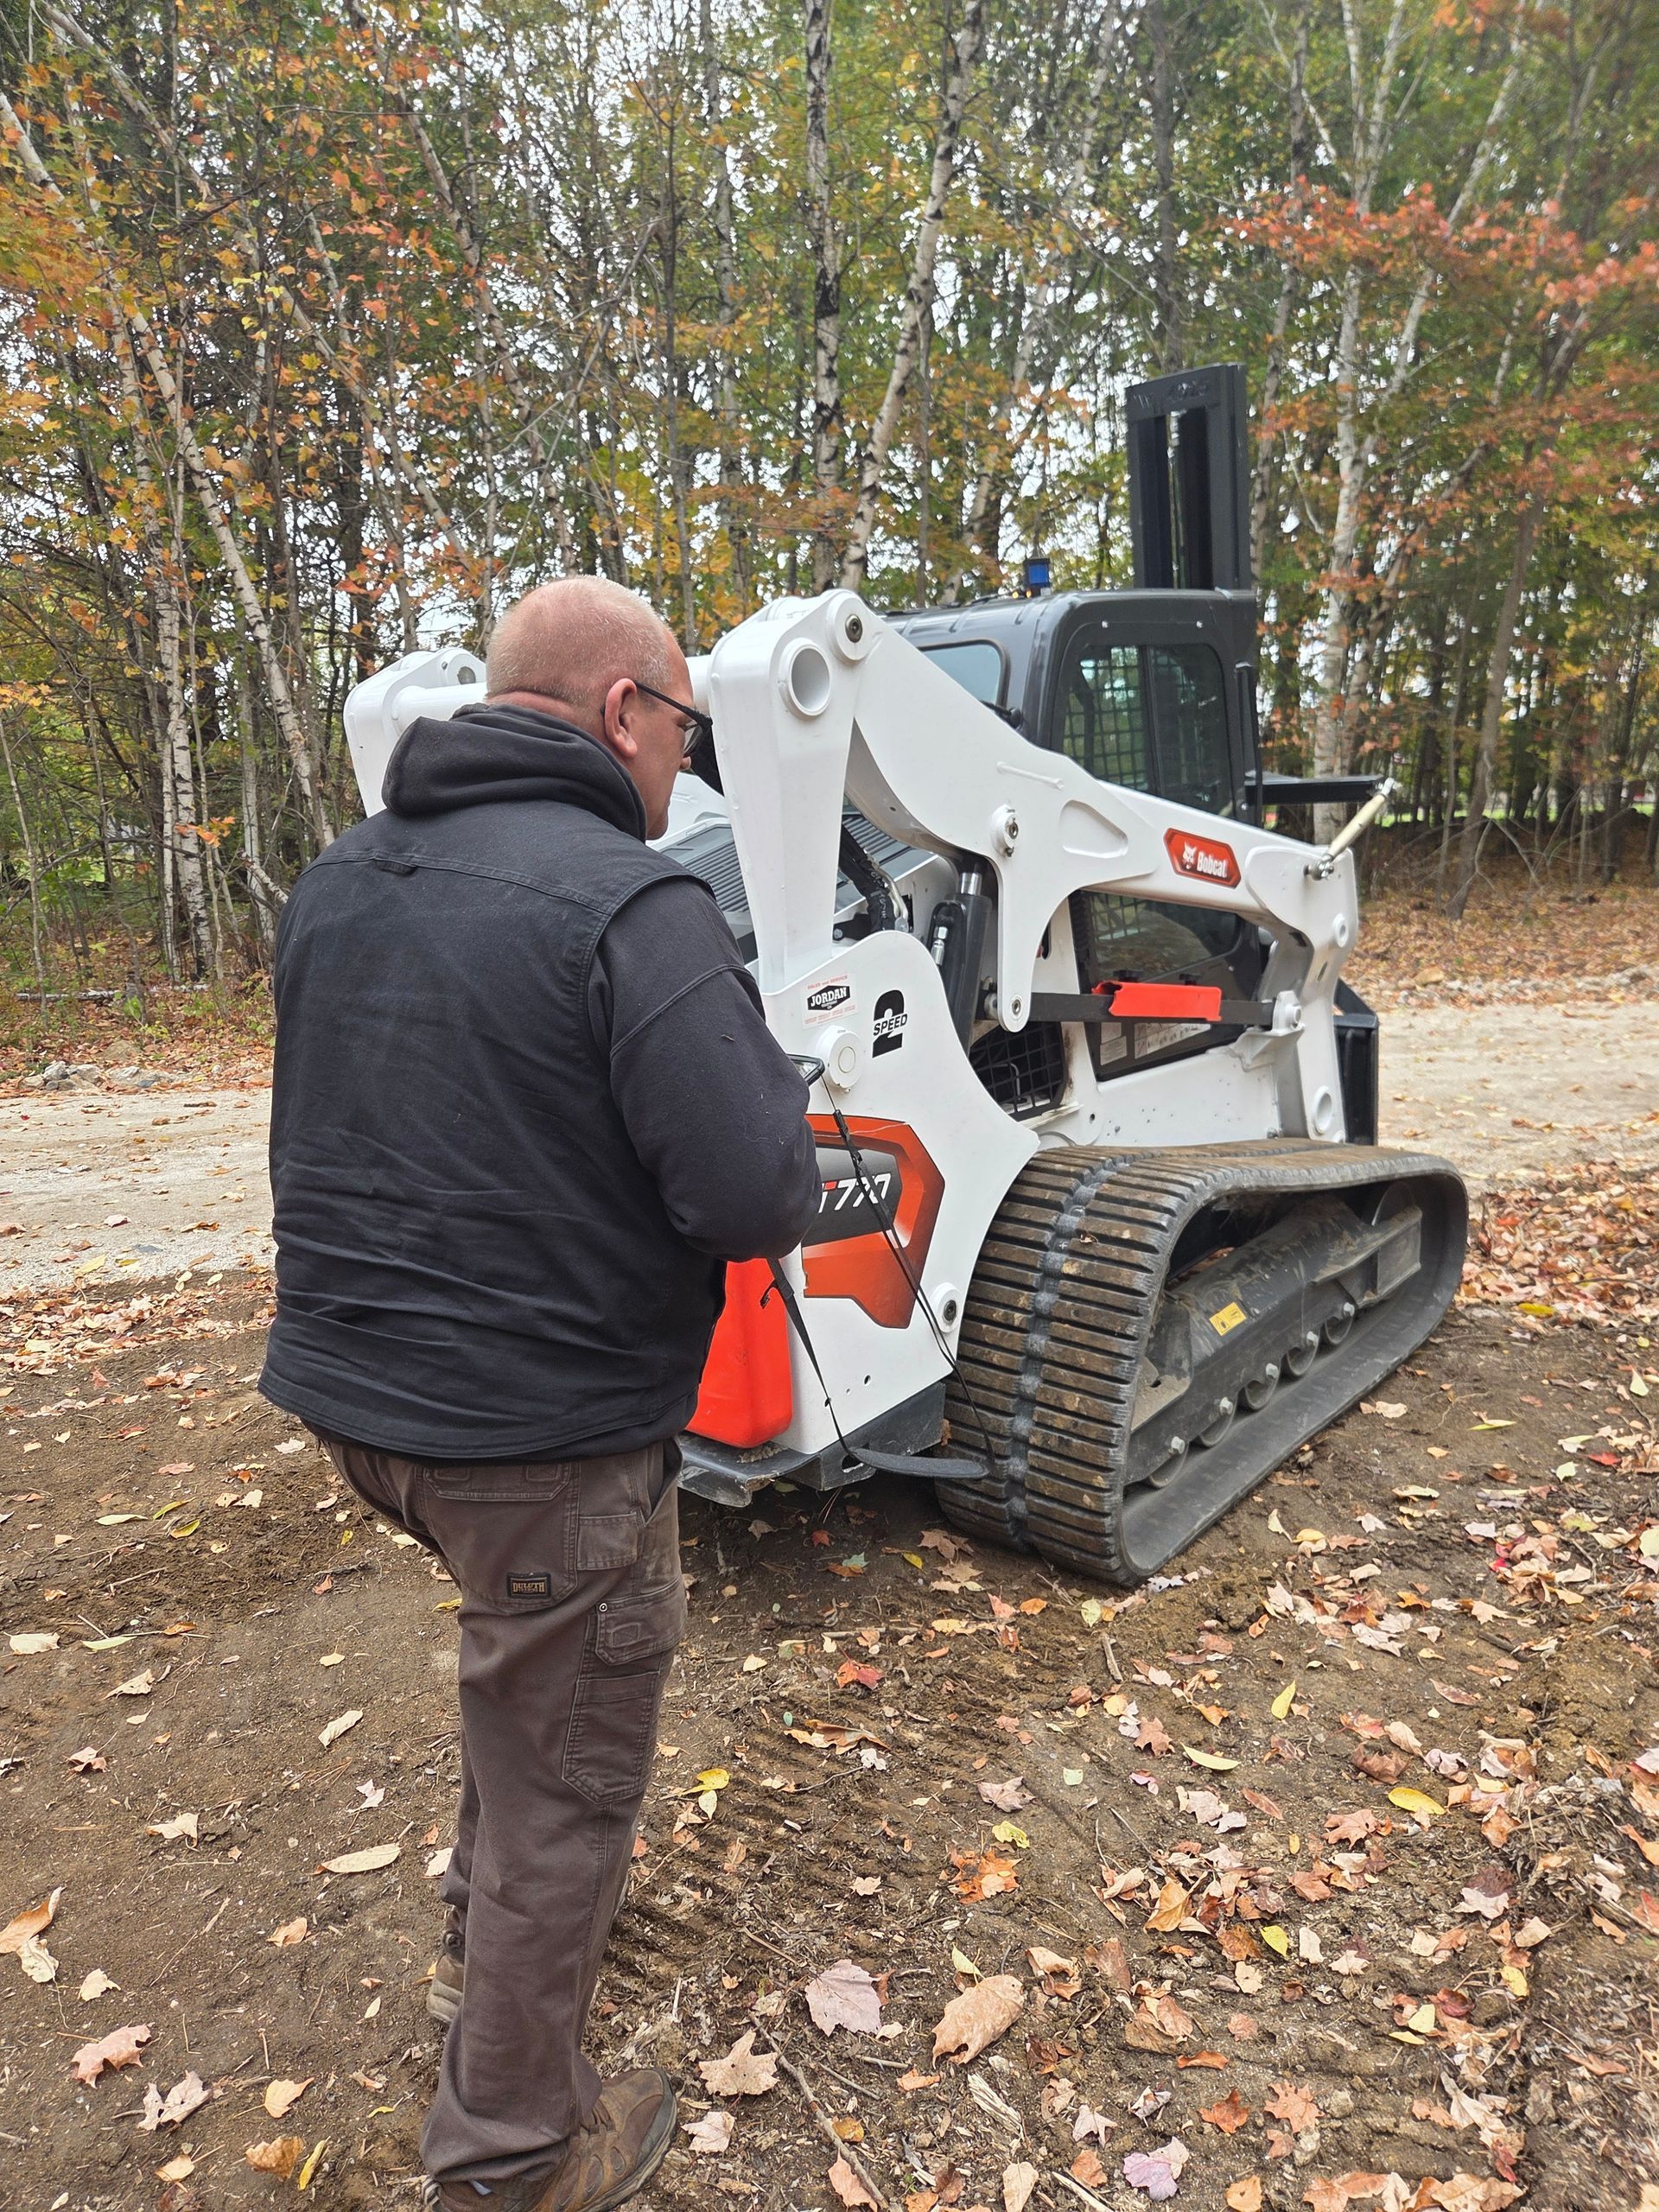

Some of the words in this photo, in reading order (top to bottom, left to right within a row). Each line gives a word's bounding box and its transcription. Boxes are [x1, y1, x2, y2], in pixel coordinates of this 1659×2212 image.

[1197, 852, 1228, 878] Bobcat
[810, 987, 847, 1007] JORDAN
[872, 989, 905, 1058] 2
[873, 1014, 908, 1036] SPEED
[512, 1582, 545, 1592] DULUTH
